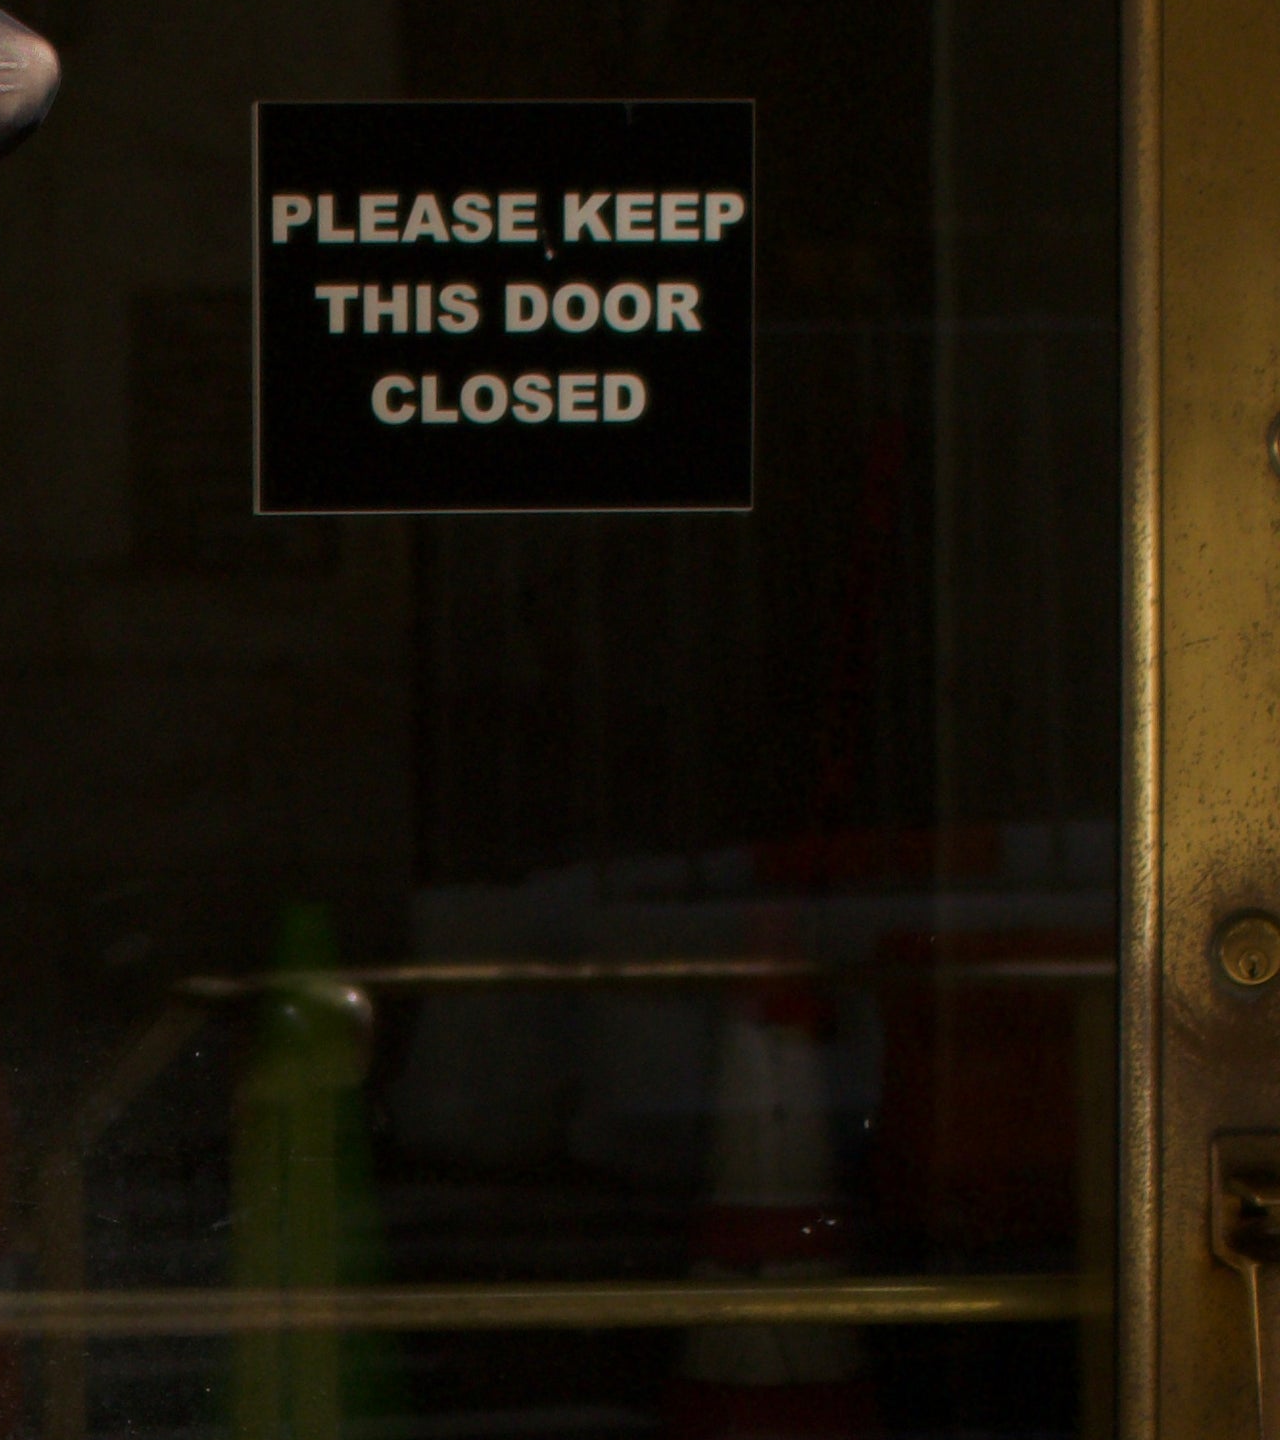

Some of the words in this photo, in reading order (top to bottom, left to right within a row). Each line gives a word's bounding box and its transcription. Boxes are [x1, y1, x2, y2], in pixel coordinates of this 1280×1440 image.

[271, 193, 538, 243] PLEASE
[563, 192, 745, 242] KEEP
[314, 283, 480, 333] THIS
[504, 281, 702, 333] DOOR
[370, 373, 646, 424] CLOSED
